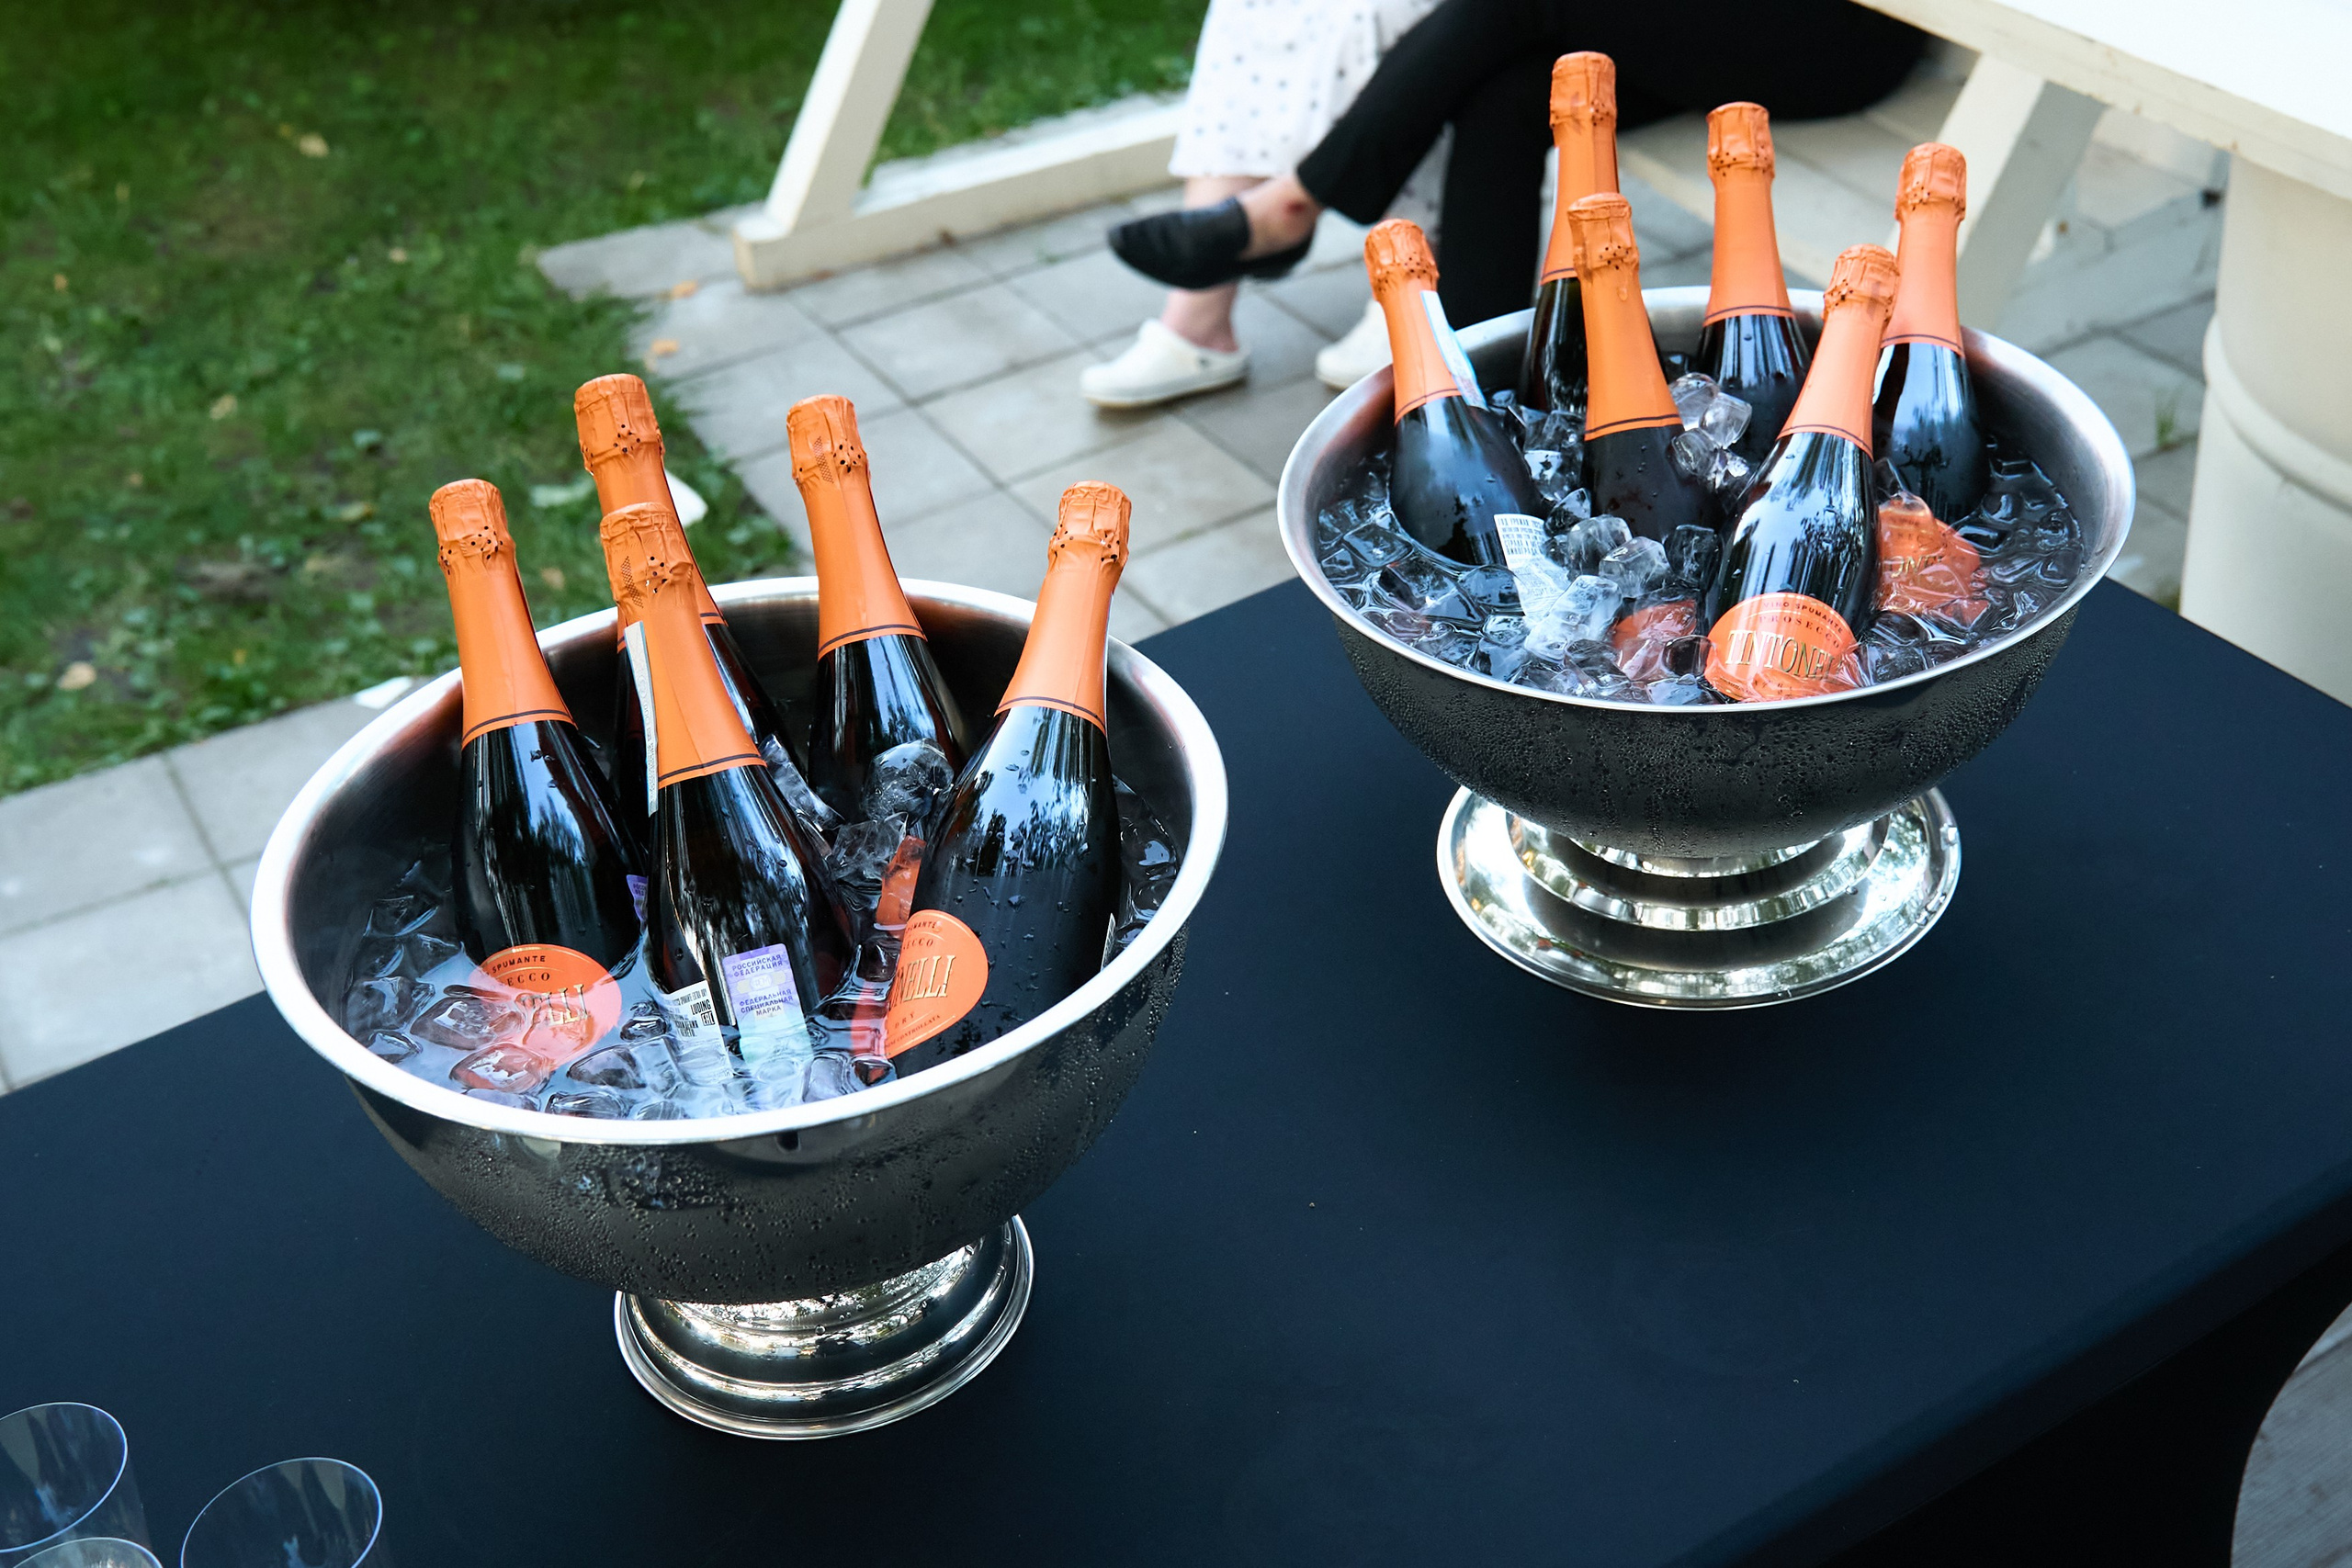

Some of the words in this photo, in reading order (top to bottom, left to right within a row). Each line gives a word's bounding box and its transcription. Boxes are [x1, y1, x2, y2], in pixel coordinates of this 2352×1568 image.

[1795, 604, 1843, 635] SPUMANTE
[1758, 615, 1840, 649] PROSECCO
[1724, 628, 1836, 681] TINTONEL
[492, 954, 547, 974] SPUMANTE
[731, 953, 782, 971] РОССИЙСКАЯ
[733, 960, 783, 977] ФЕДЕРАЦИЯ
[690, 999, 711, 1015] LUDING
[739, 988, 792, 1007] ФЕДЕРАЛЬНАЯ
[741, 995, 794, 1014] СПЕЦИАЛЬНАЯ
[755, 1005, 782, 1017] МАРКА
